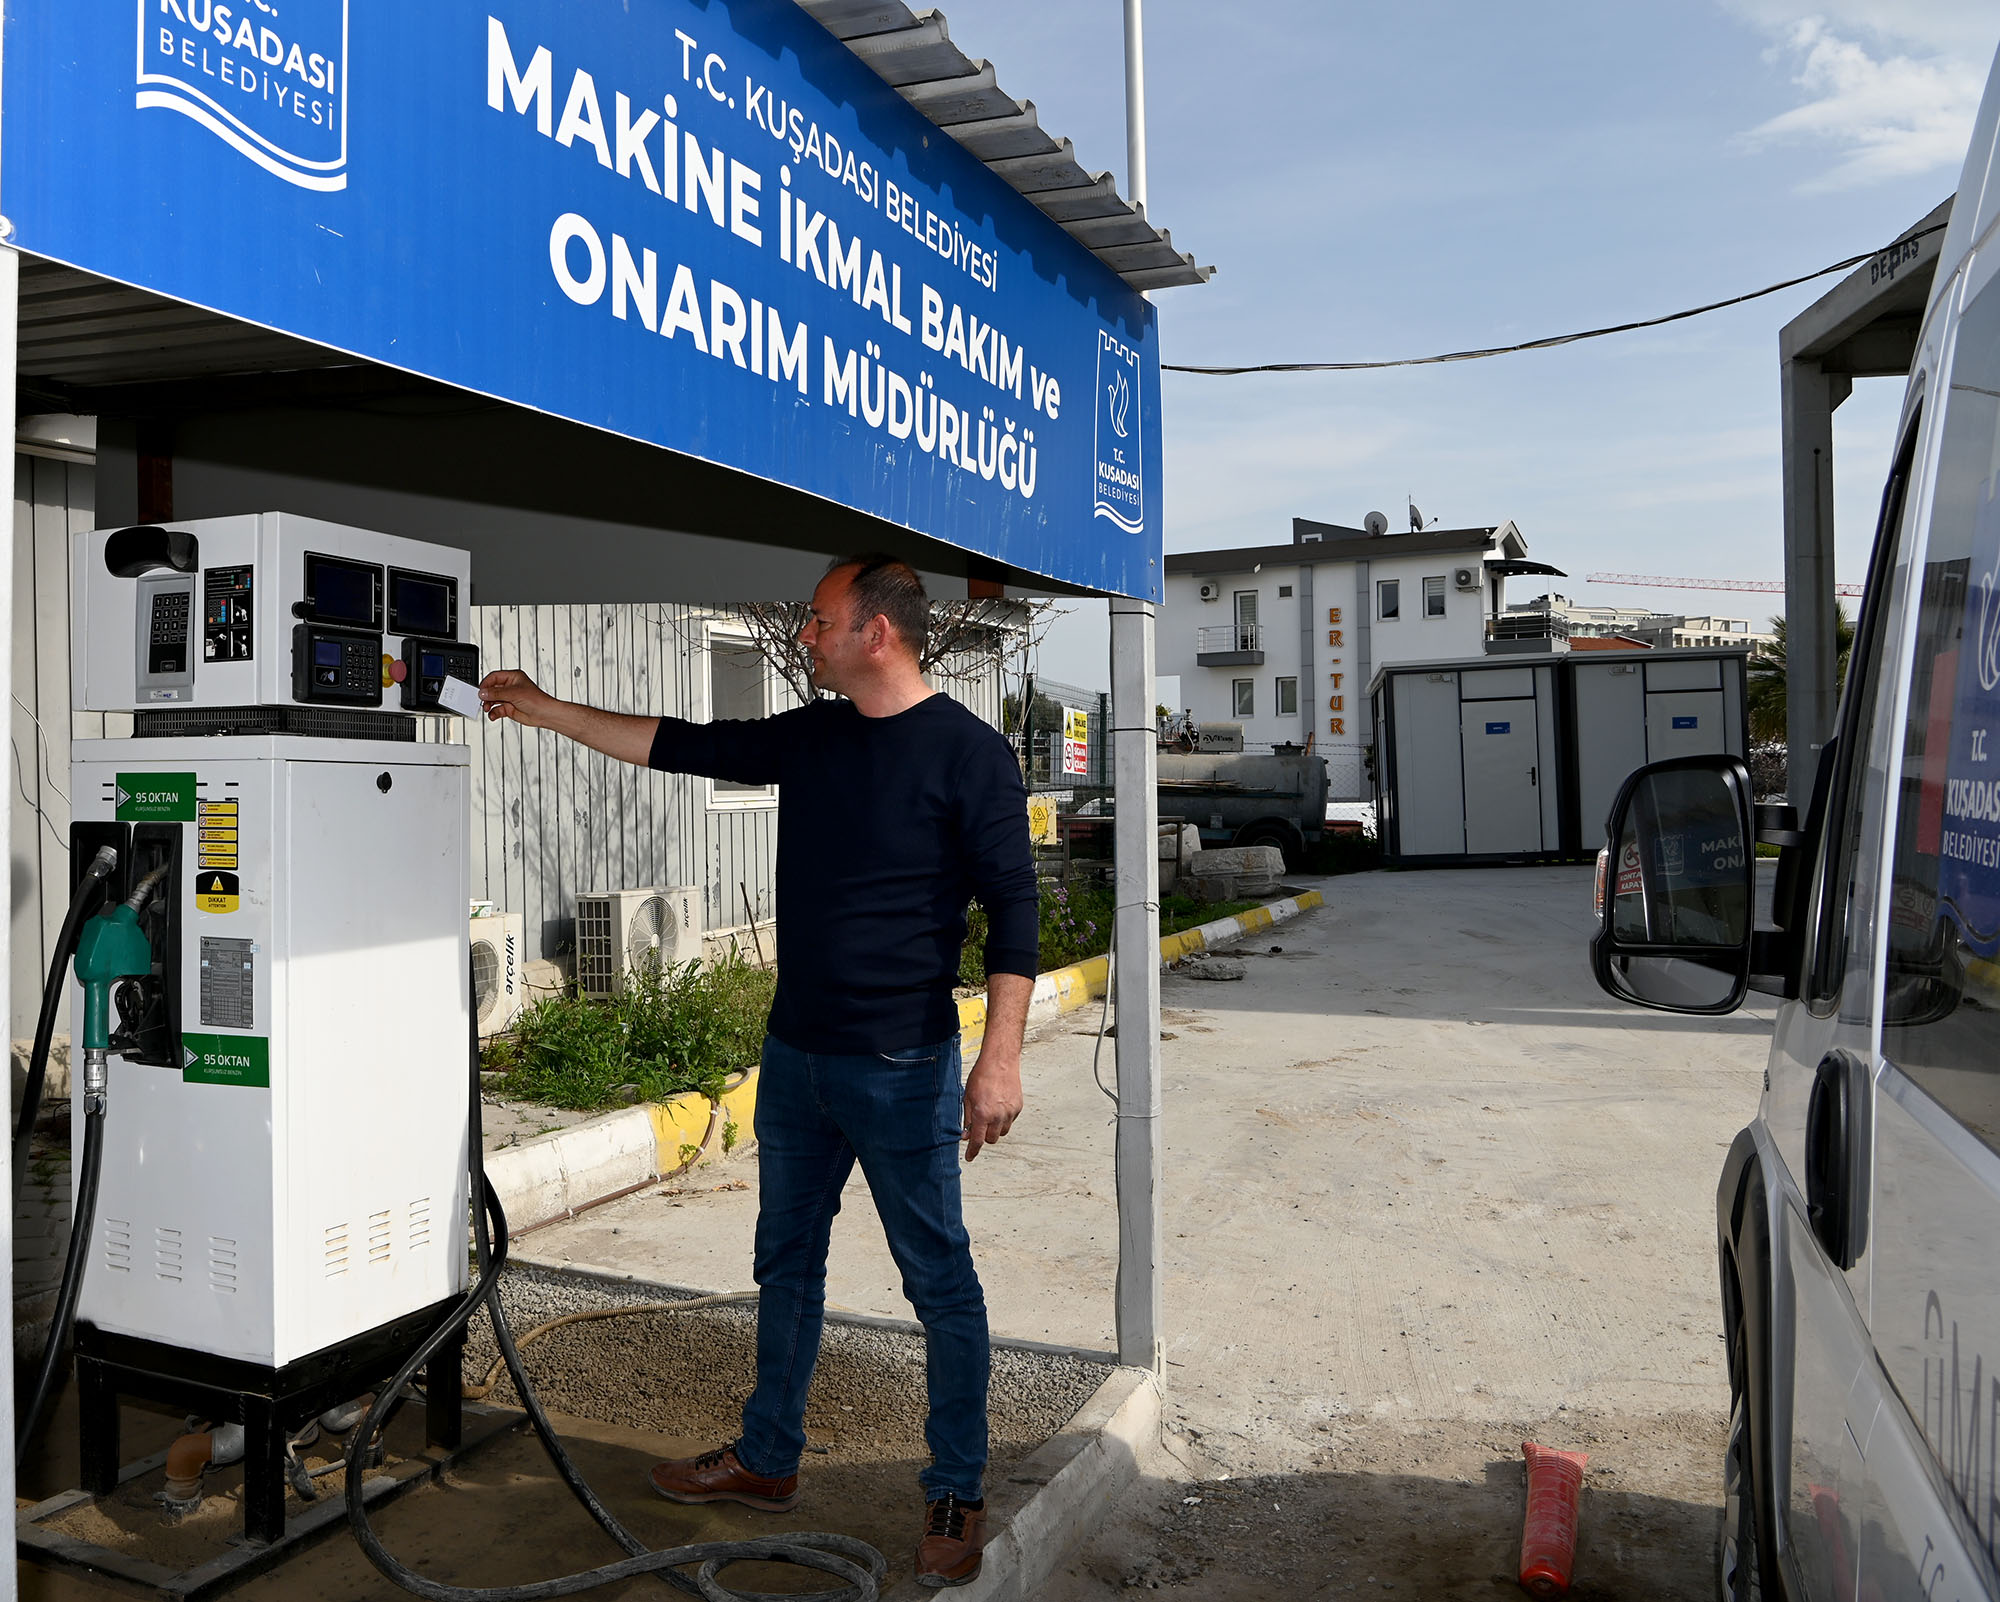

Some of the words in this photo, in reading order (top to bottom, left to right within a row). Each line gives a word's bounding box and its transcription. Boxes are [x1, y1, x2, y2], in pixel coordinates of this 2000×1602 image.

[160, 27, 333, 131] BELEDİYESİ
[675, 28, 735, 110] T.C.
[746, 76, 879, 210] KUŞADASI
[886, 180, 998, 293] BELEDİYESİ
[487, 14, 762, 247] MAKİNE
[779, 164, 912, 336] İKMAL
[921, 291, 1023, 400] BAKIM
[1030, 370, 1061, 420] ve
[549, 212, 808, 395] ONARIM
[823, 335, 1037, 500] MÜDÜRLÜĞÜ
[1113, 447, 1126, 464] T.C.
[1098, 461, 1140, 491] KUŞADASI
[1098, 482, 1140, 506] BELEDİYESİ
[1970, 728, 1987, 762] T.C.
[135, 792, 147, 803] 95
[148, 792, 179, 803] OKTAN
[1945, 778, 2000, 823] KUŞADAS
[505, 933, 514, 996] arçelik
[203, 1053, 216, 1065] 95
[217, 1054, 250, 1067] OKTAN
